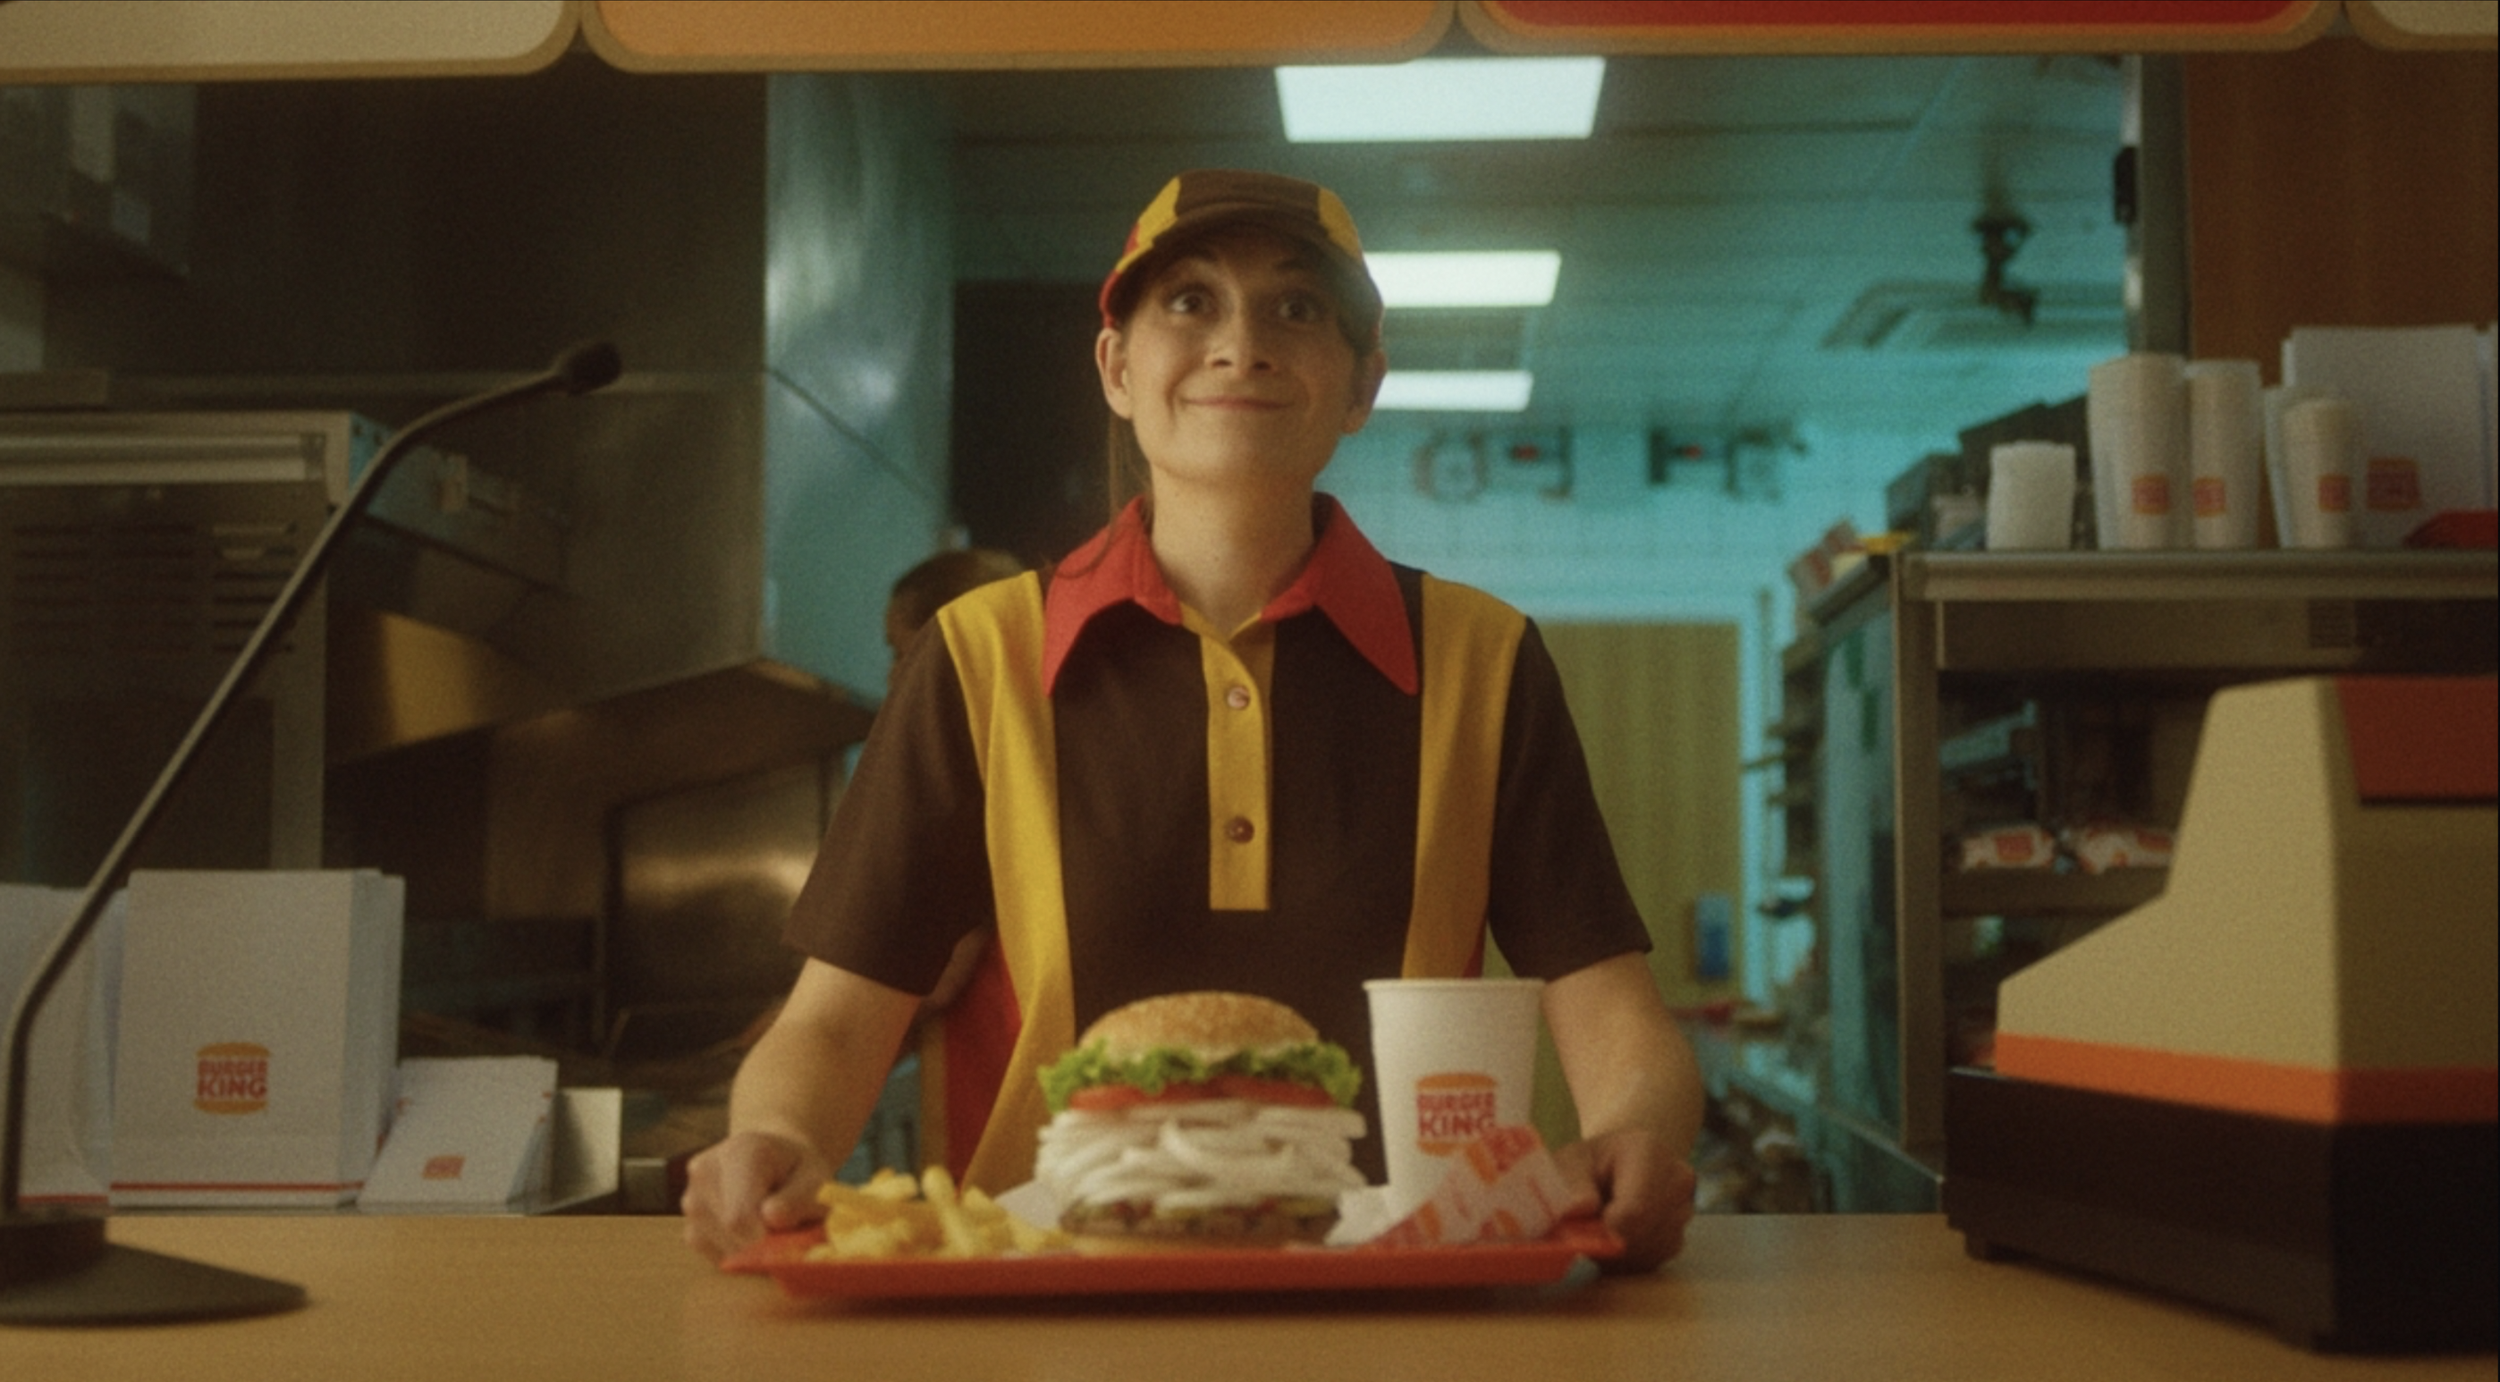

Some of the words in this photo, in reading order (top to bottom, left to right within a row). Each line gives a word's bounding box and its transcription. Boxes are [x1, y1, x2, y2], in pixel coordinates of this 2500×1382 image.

[198, 1060, 268, 1078] BURGER
[198, 1076, 267, 1099] KING
[1417, 1111, 1495, 1137] KING
